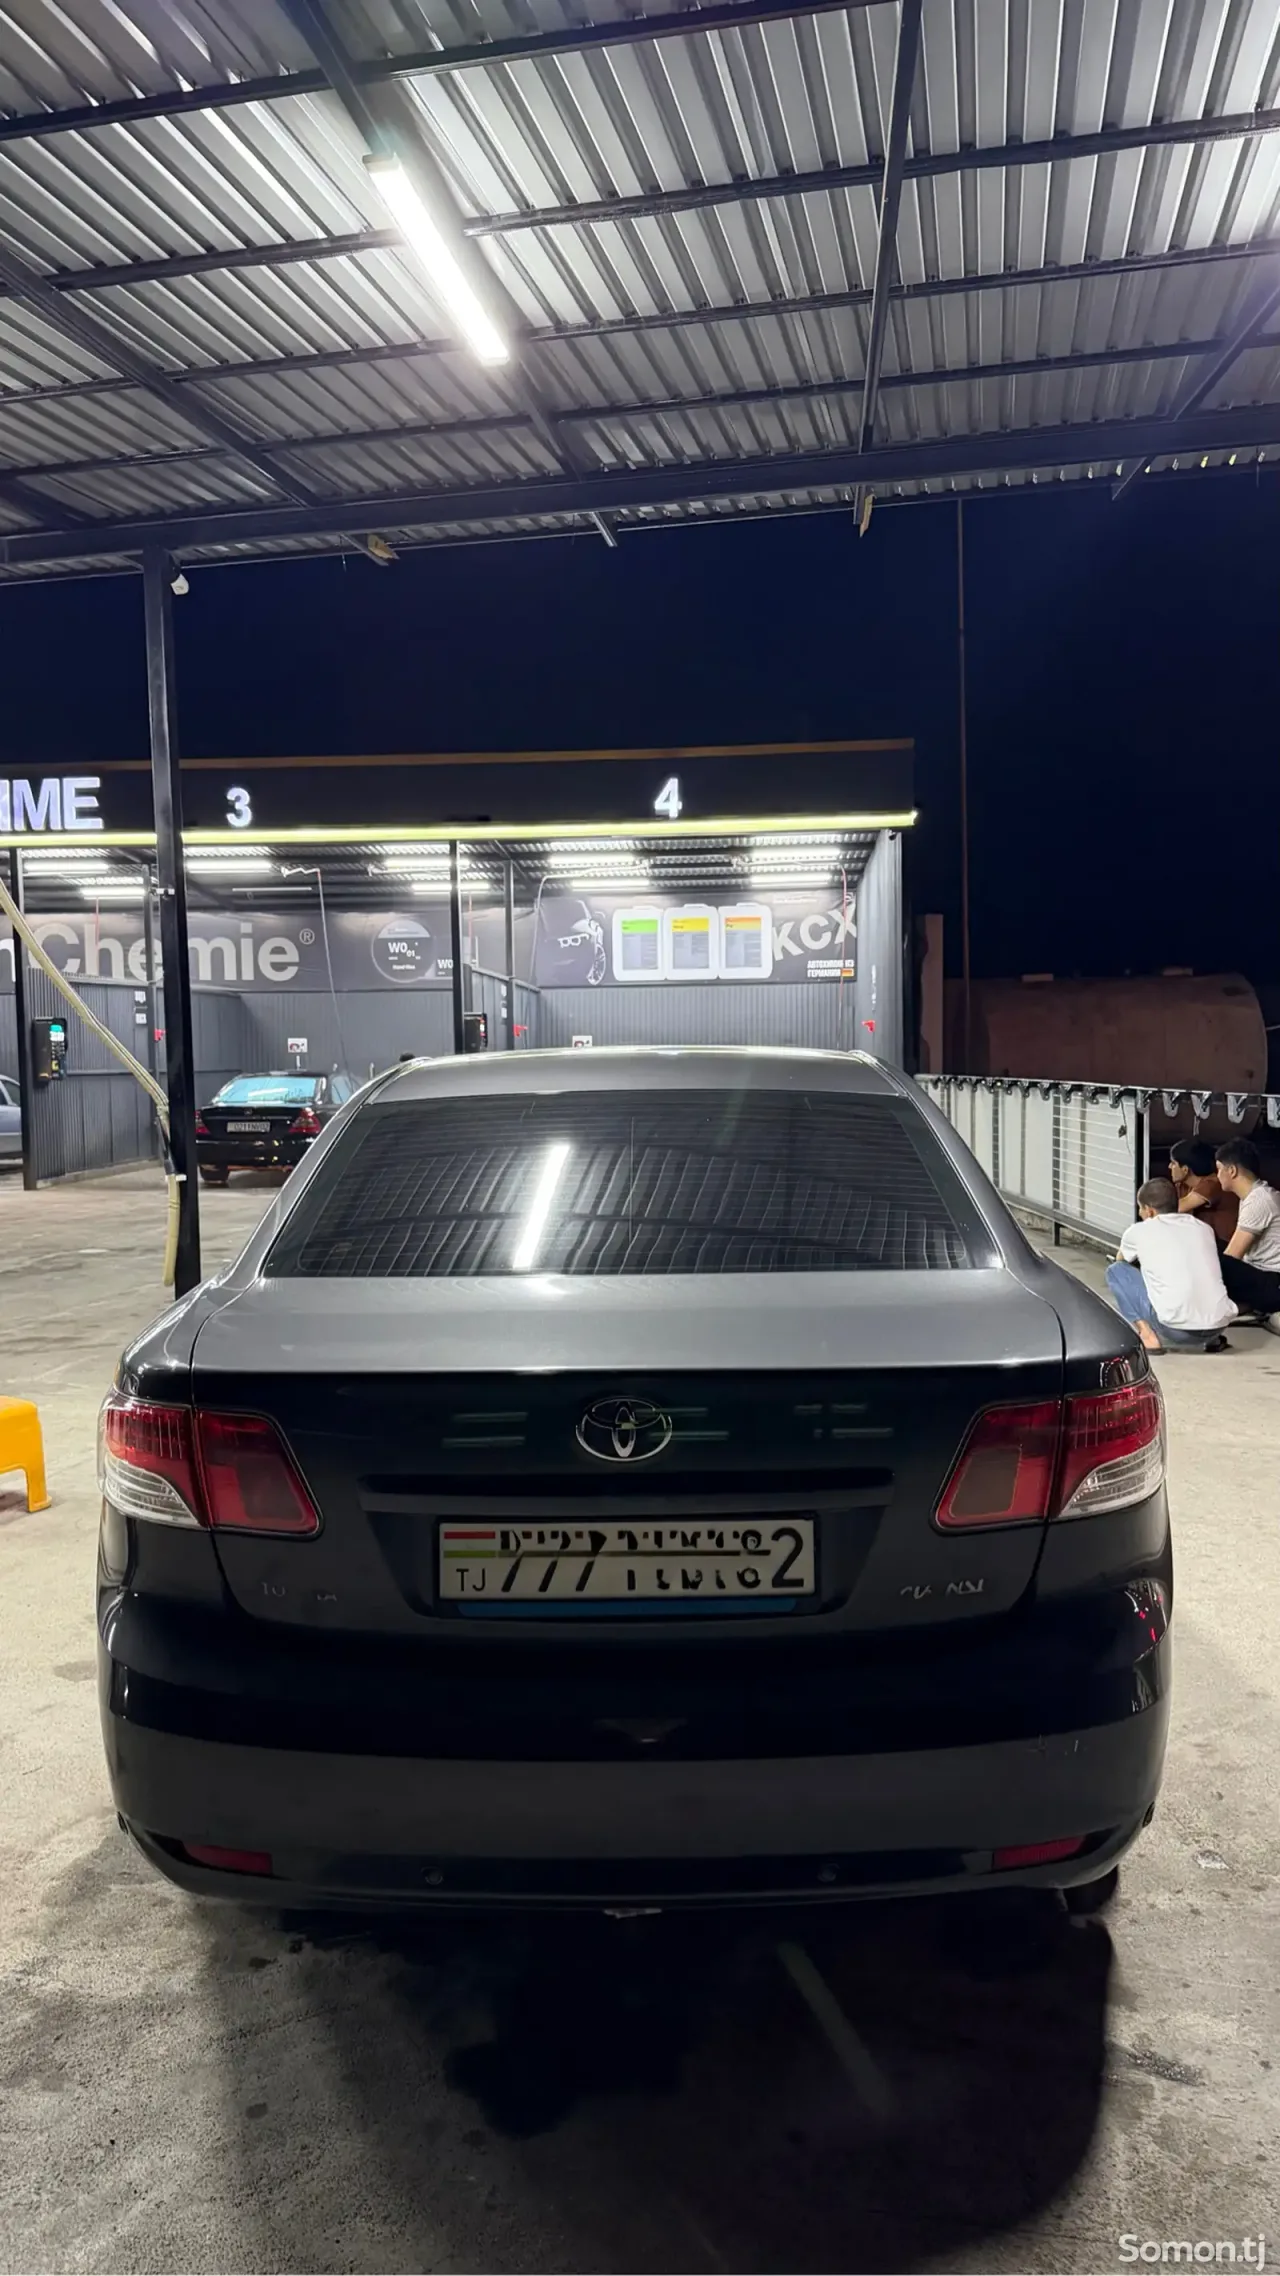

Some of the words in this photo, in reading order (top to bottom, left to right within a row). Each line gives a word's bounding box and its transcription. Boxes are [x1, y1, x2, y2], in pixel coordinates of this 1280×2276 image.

[226, 787, 252, 827] 3
[654, 777, 682, 818] 4
[772, 898, 857, 961] KCX
[456, 1568, 486, 1592] TJ
